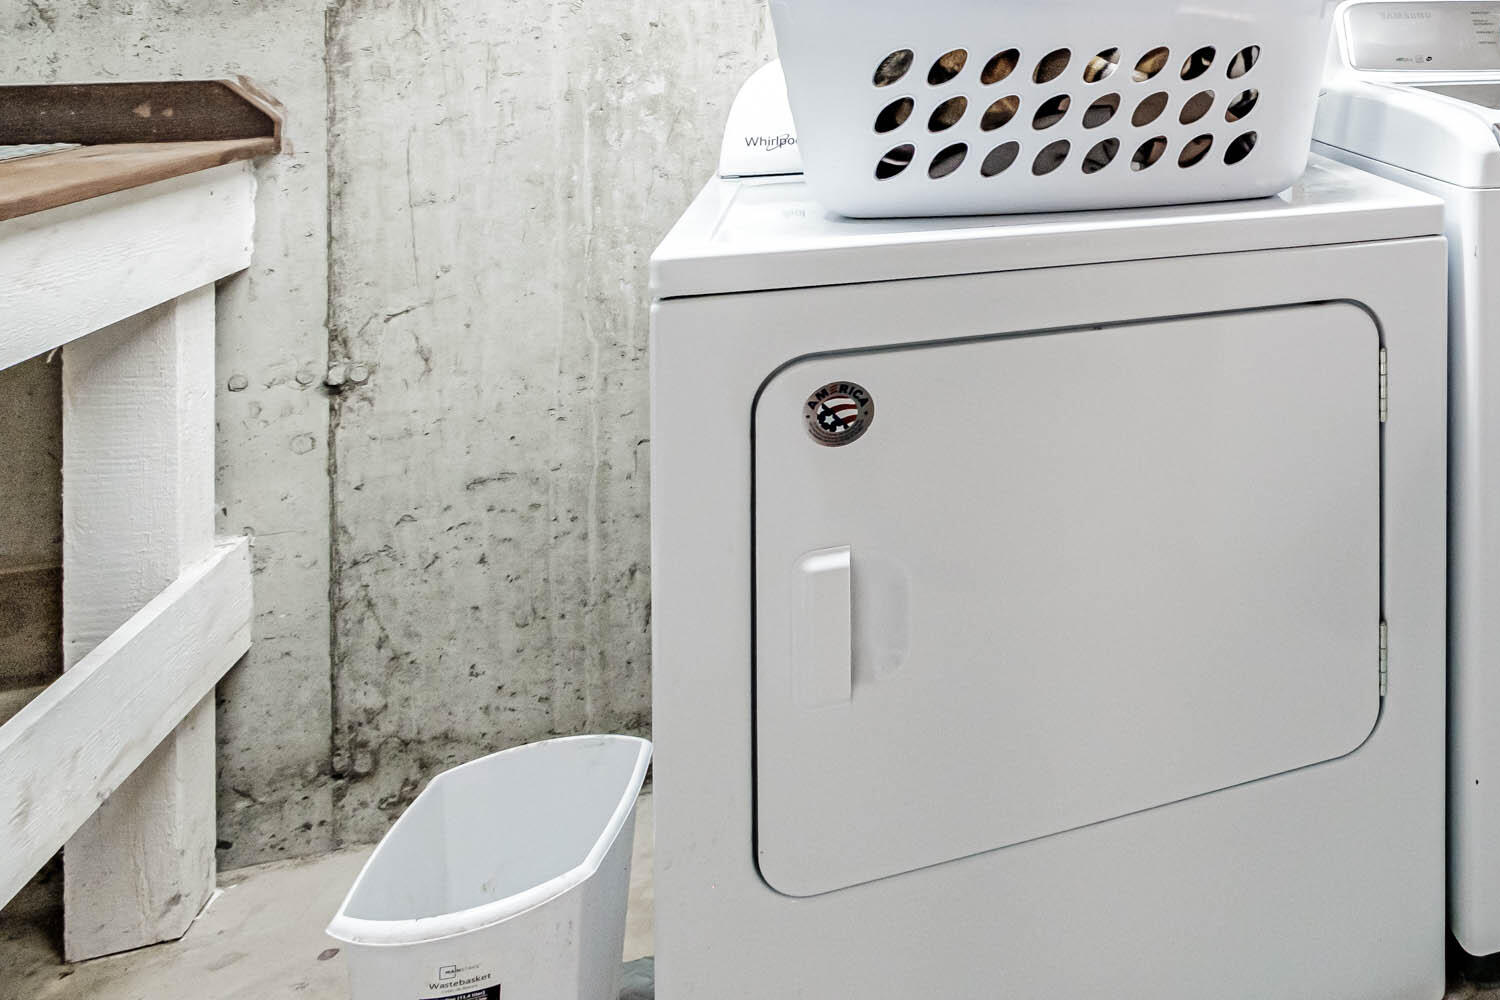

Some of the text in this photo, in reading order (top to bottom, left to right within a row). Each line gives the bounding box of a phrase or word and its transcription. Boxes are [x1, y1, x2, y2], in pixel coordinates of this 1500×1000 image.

[745, 134, 799, 151] Whirlpo
[808, 384, 869, 410] AMERICA
[429, 973, 492, 990] Wastebasket
